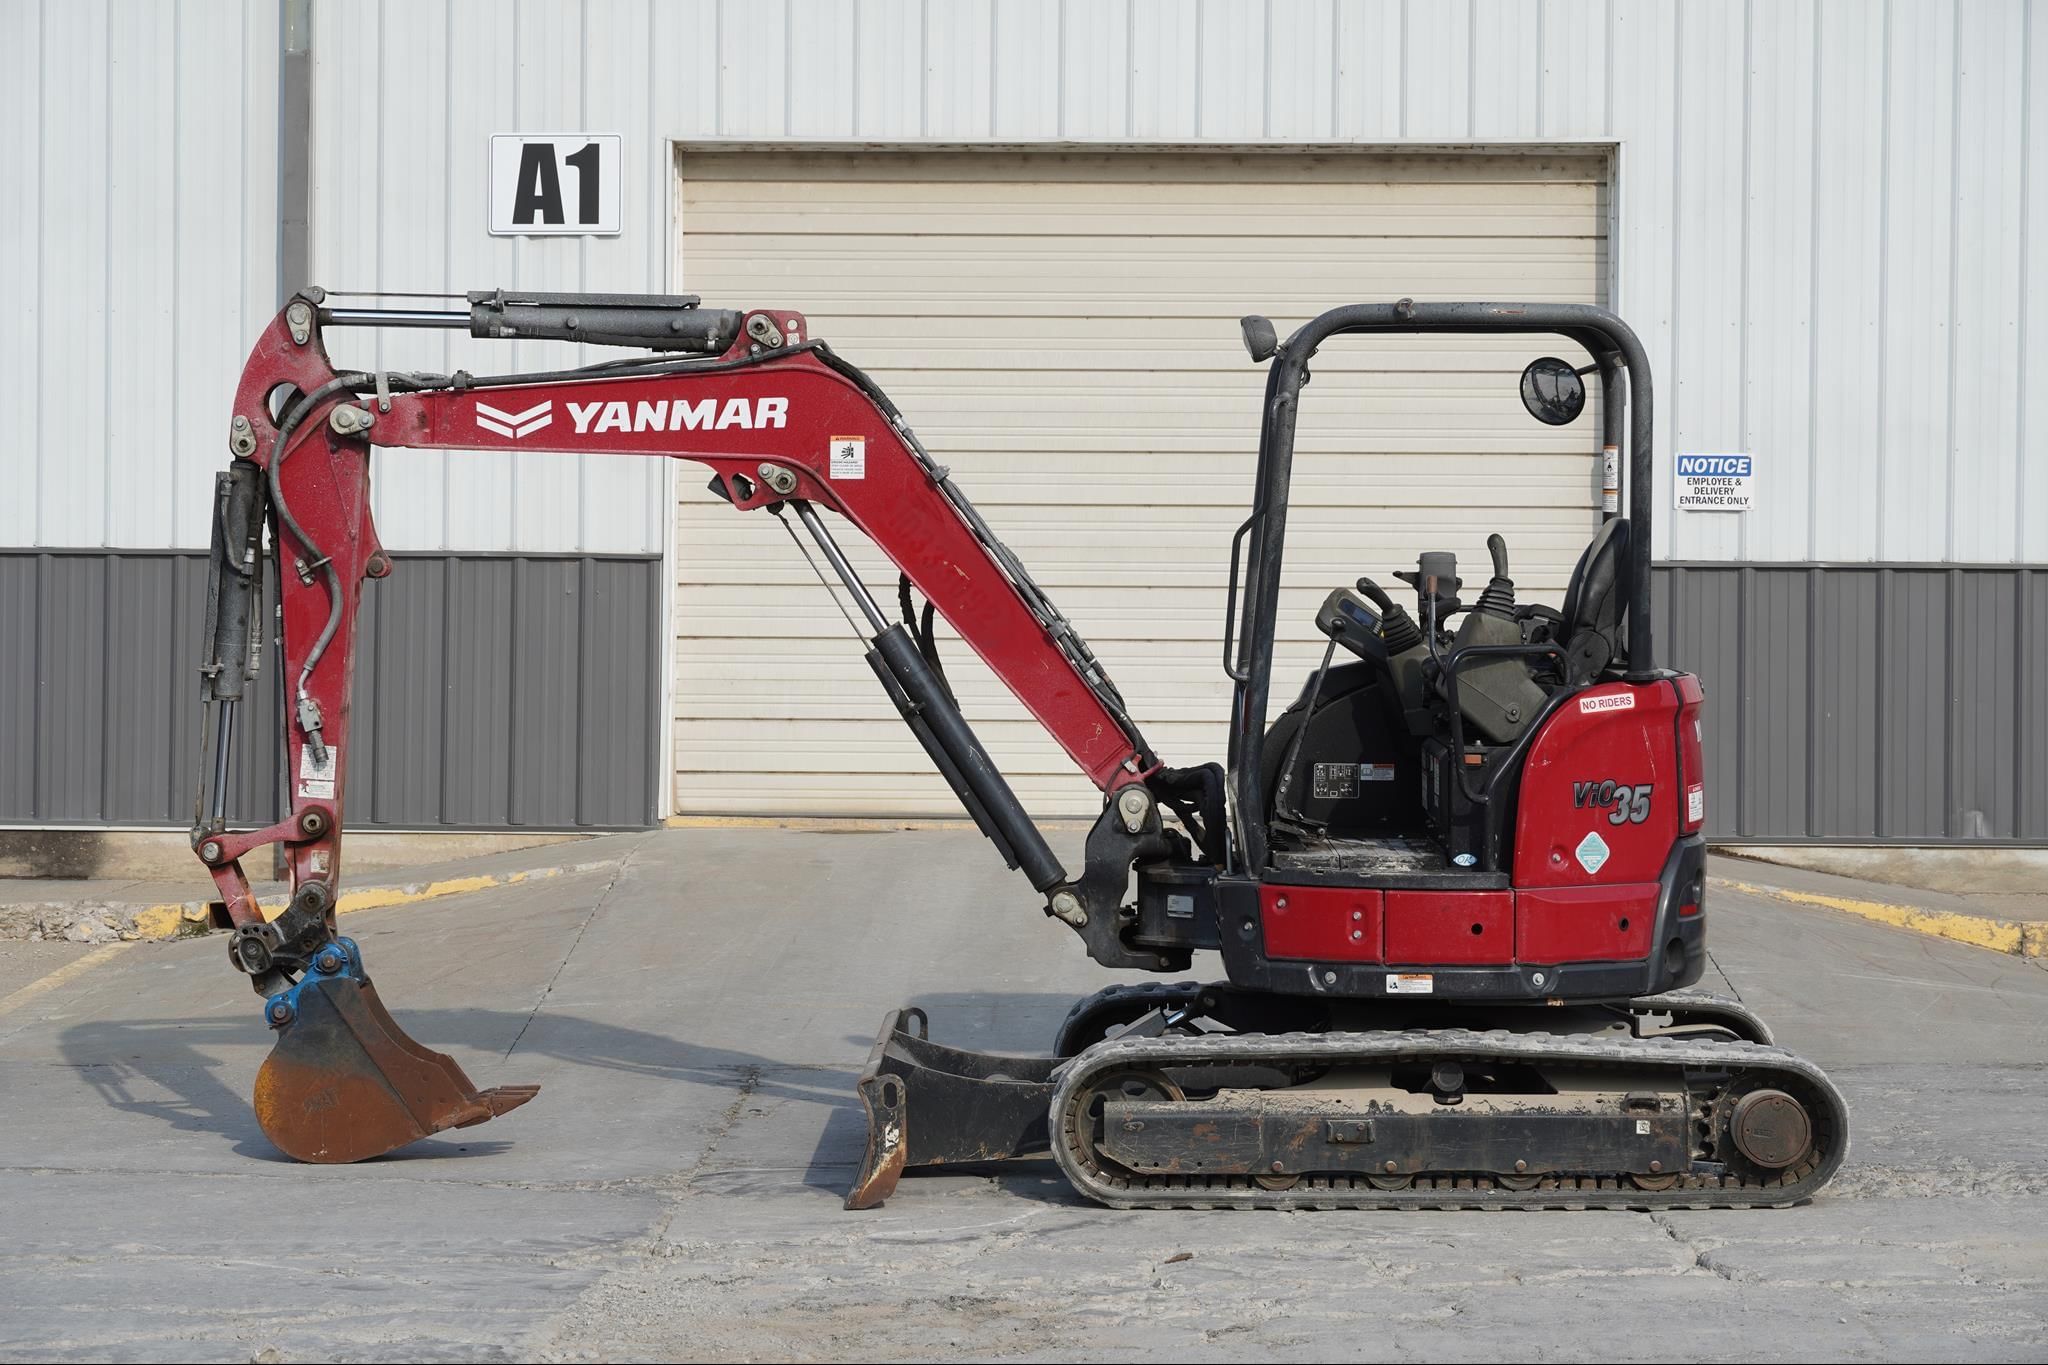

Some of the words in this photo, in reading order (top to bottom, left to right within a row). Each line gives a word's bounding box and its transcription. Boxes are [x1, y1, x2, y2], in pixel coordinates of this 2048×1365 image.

[512, 143, 600, 224] A1
[566, 397, 789, 434] YANMAR
[1680, 458, 1750, 474] NOTICE
[1687, 477, 1733, 486] EMPLOYEE
[1734, 478, 1742, 487] &
[1694, 487, 1735, 495] DELIVERY
[1680, 496, 1725, 505] ENTRANCE
[1726, 496, 1749, 505] ONLY
[1582, 700, 1597, 710] NO
[1599, 696, 1632, 708] RIDERS
